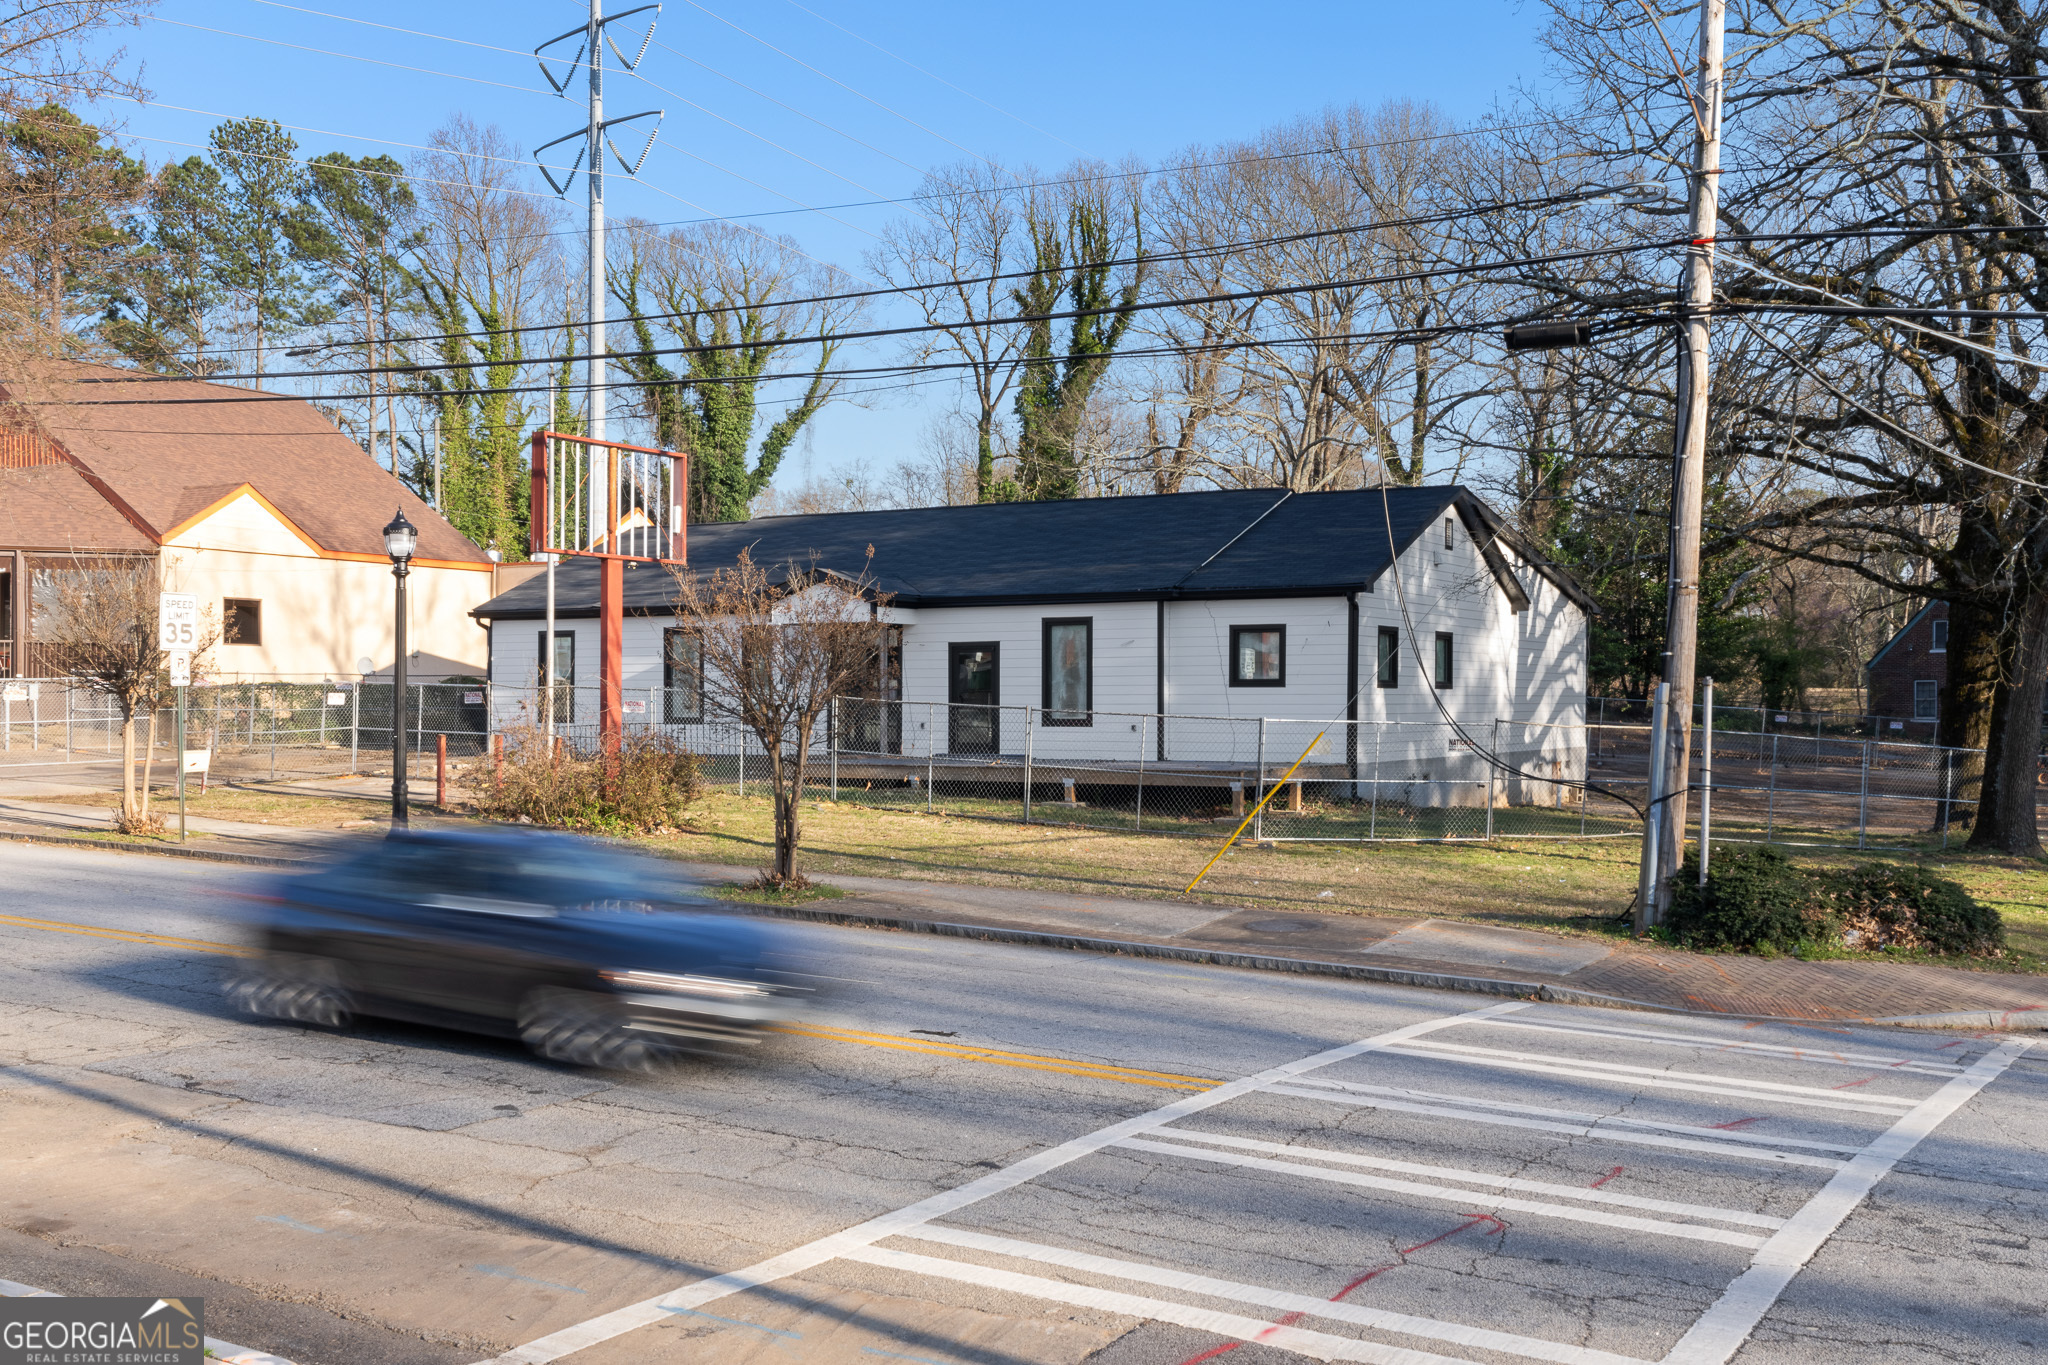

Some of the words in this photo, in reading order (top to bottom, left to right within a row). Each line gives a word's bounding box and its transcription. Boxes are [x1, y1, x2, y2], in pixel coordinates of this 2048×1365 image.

[165, 600, 194, 609] SPEED
[168, 612, 190, 620] LIMIT
[165, 623, 193, 644] 35
